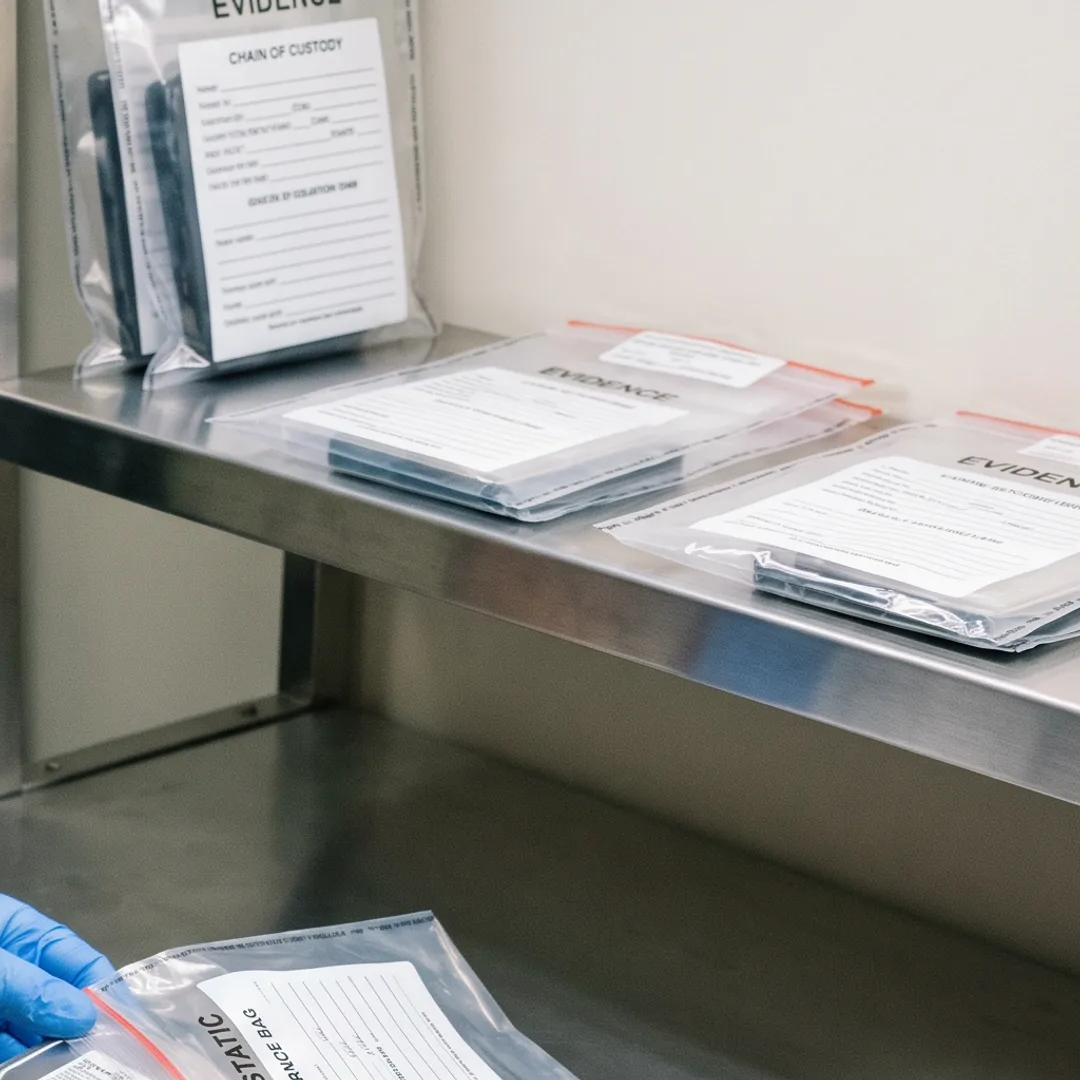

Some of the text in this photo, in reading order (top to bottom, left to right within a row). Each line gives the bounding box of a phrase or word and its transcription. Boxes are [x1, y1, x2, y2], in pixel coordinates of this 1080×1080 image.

[228, 38, 343, 65] CHAIN OF CUSTODY
[538, 366, 680, 401] EVIDENCE
[242, 1008, 273, 1039] BAG
